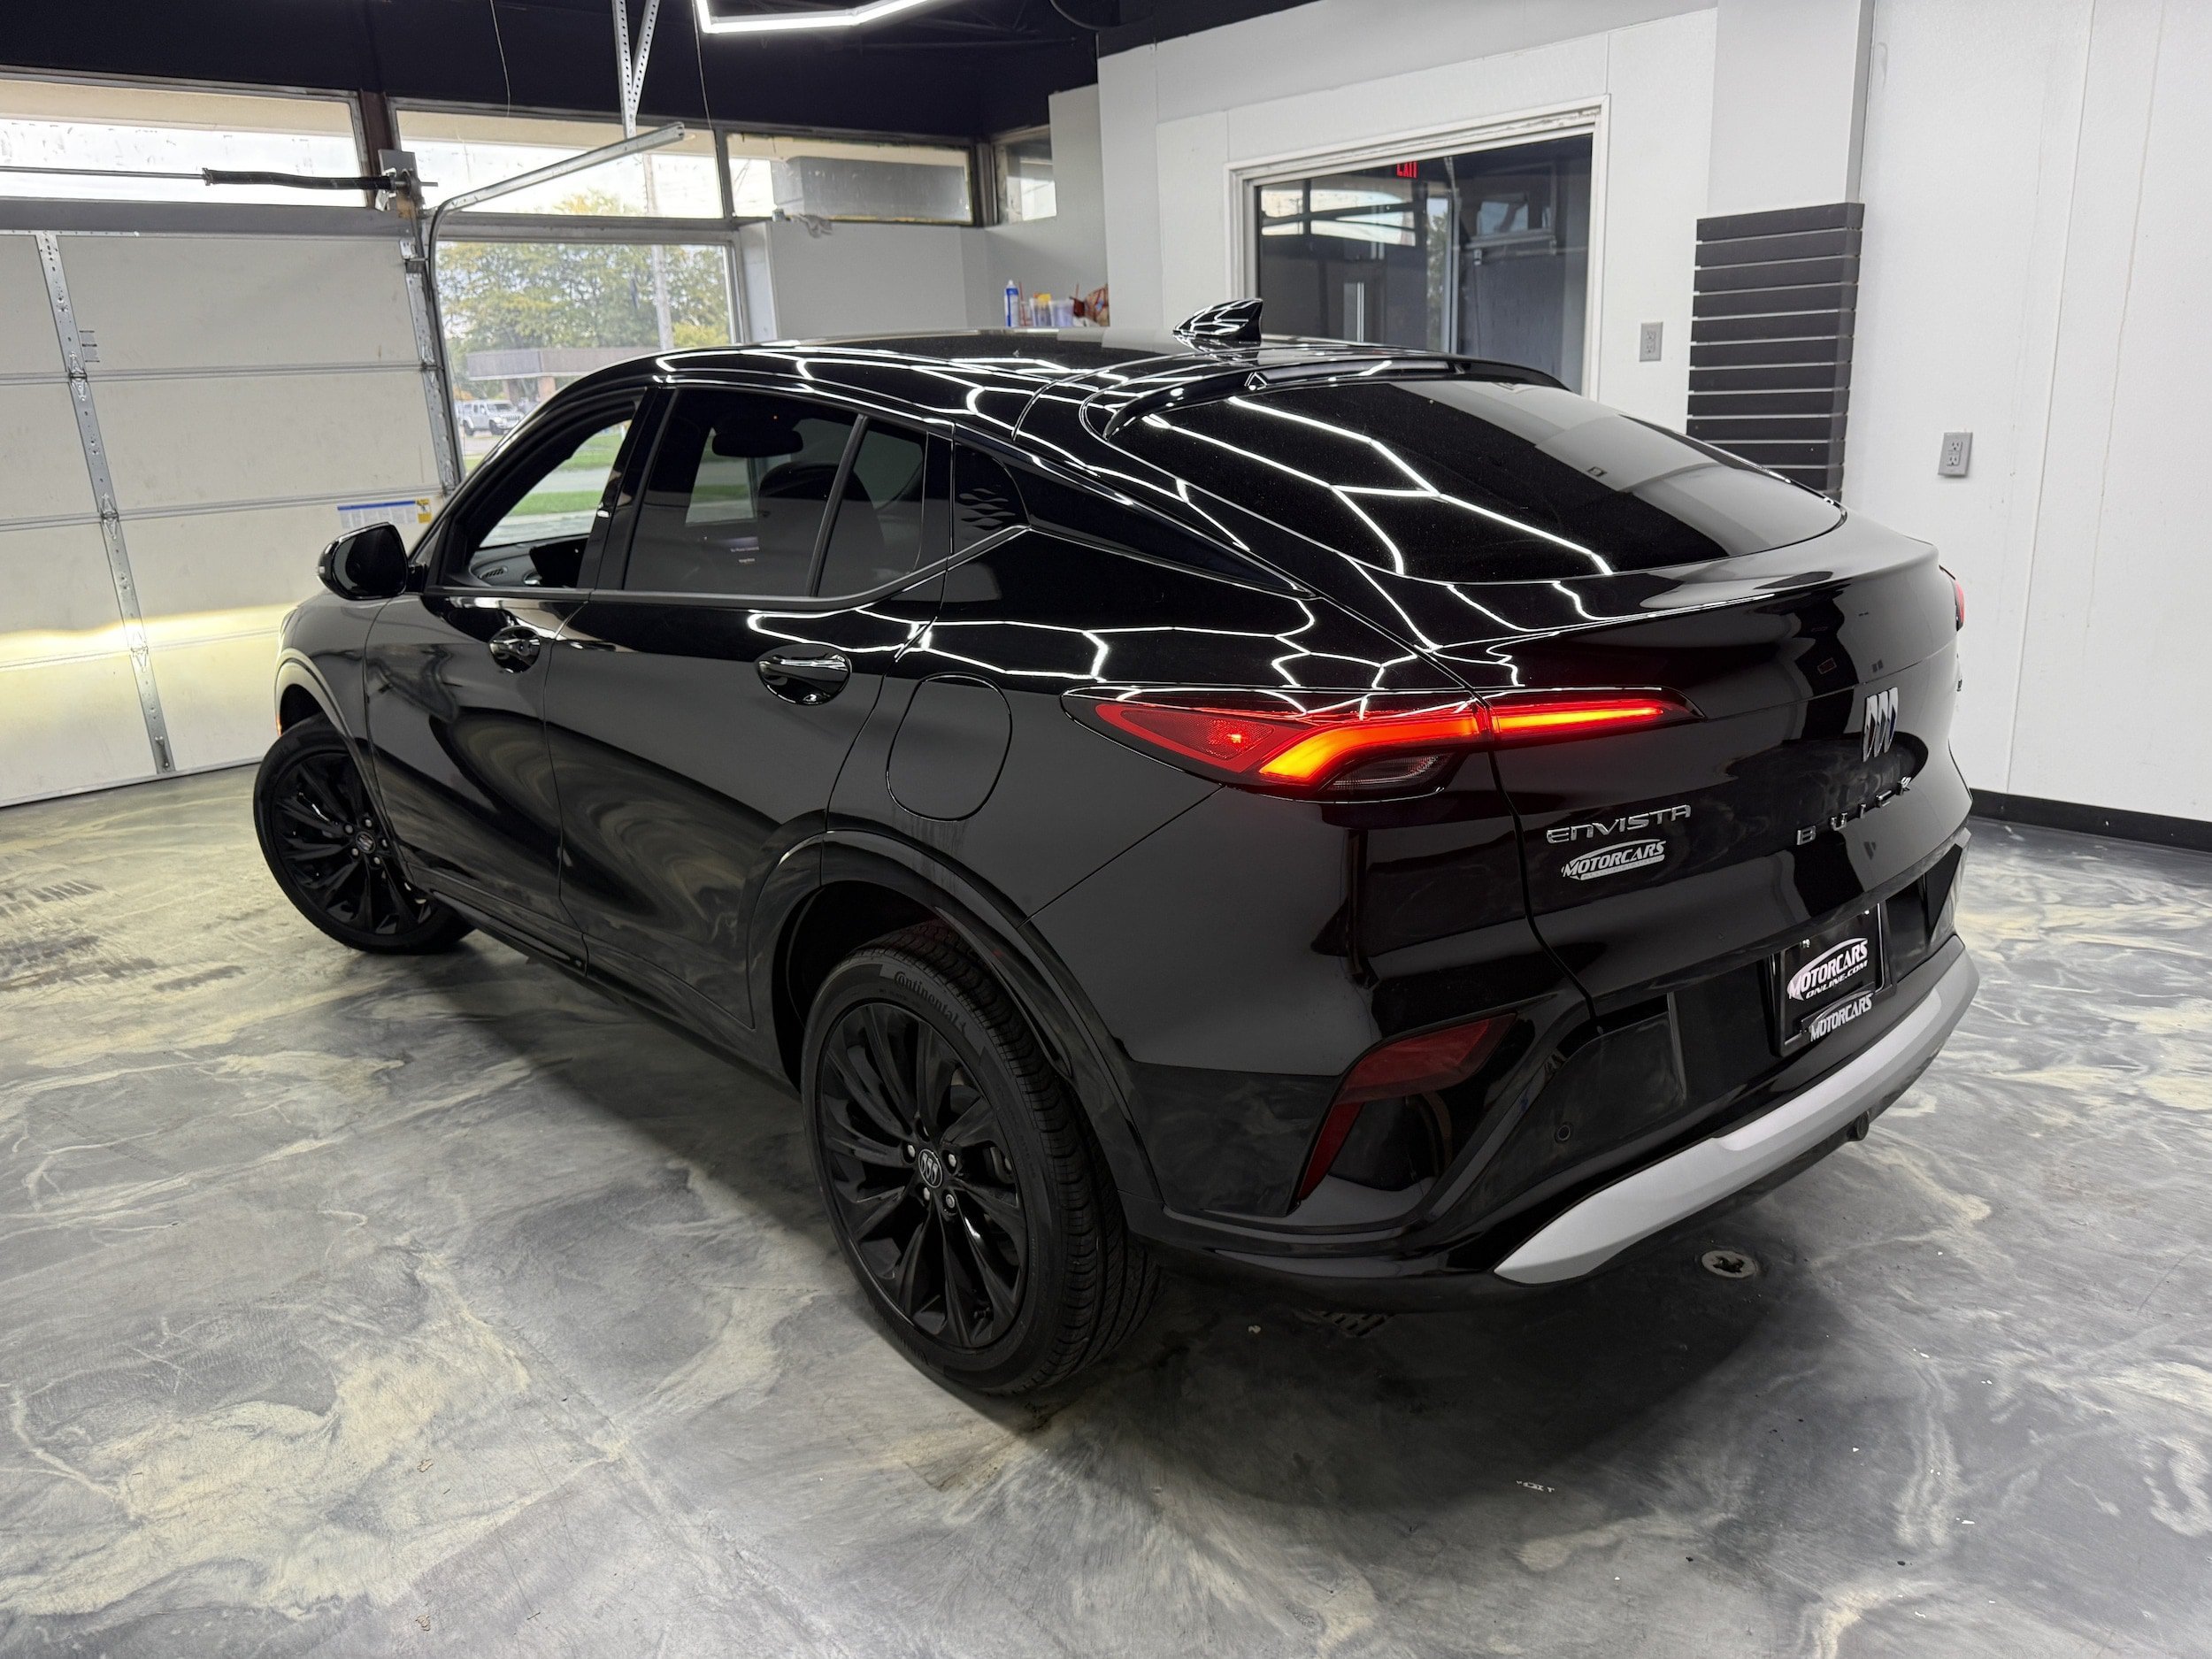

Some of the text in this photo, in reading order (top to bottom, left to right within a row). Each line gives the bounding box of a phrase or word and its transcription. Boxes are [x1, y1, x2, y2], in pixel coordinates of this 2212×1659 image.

[1546, 804, 1692, 844] ENVISTA
[1562, 840, 1667, 878] MOTORCARS
[1787, 940, 1869, 1000] MOTORCARS
[1805, 960, 1869, 999] ONLINE.COM
[894, 971, 959, 1025] Continental
[1809, 992, 1874, 1042] MOTORCARS
